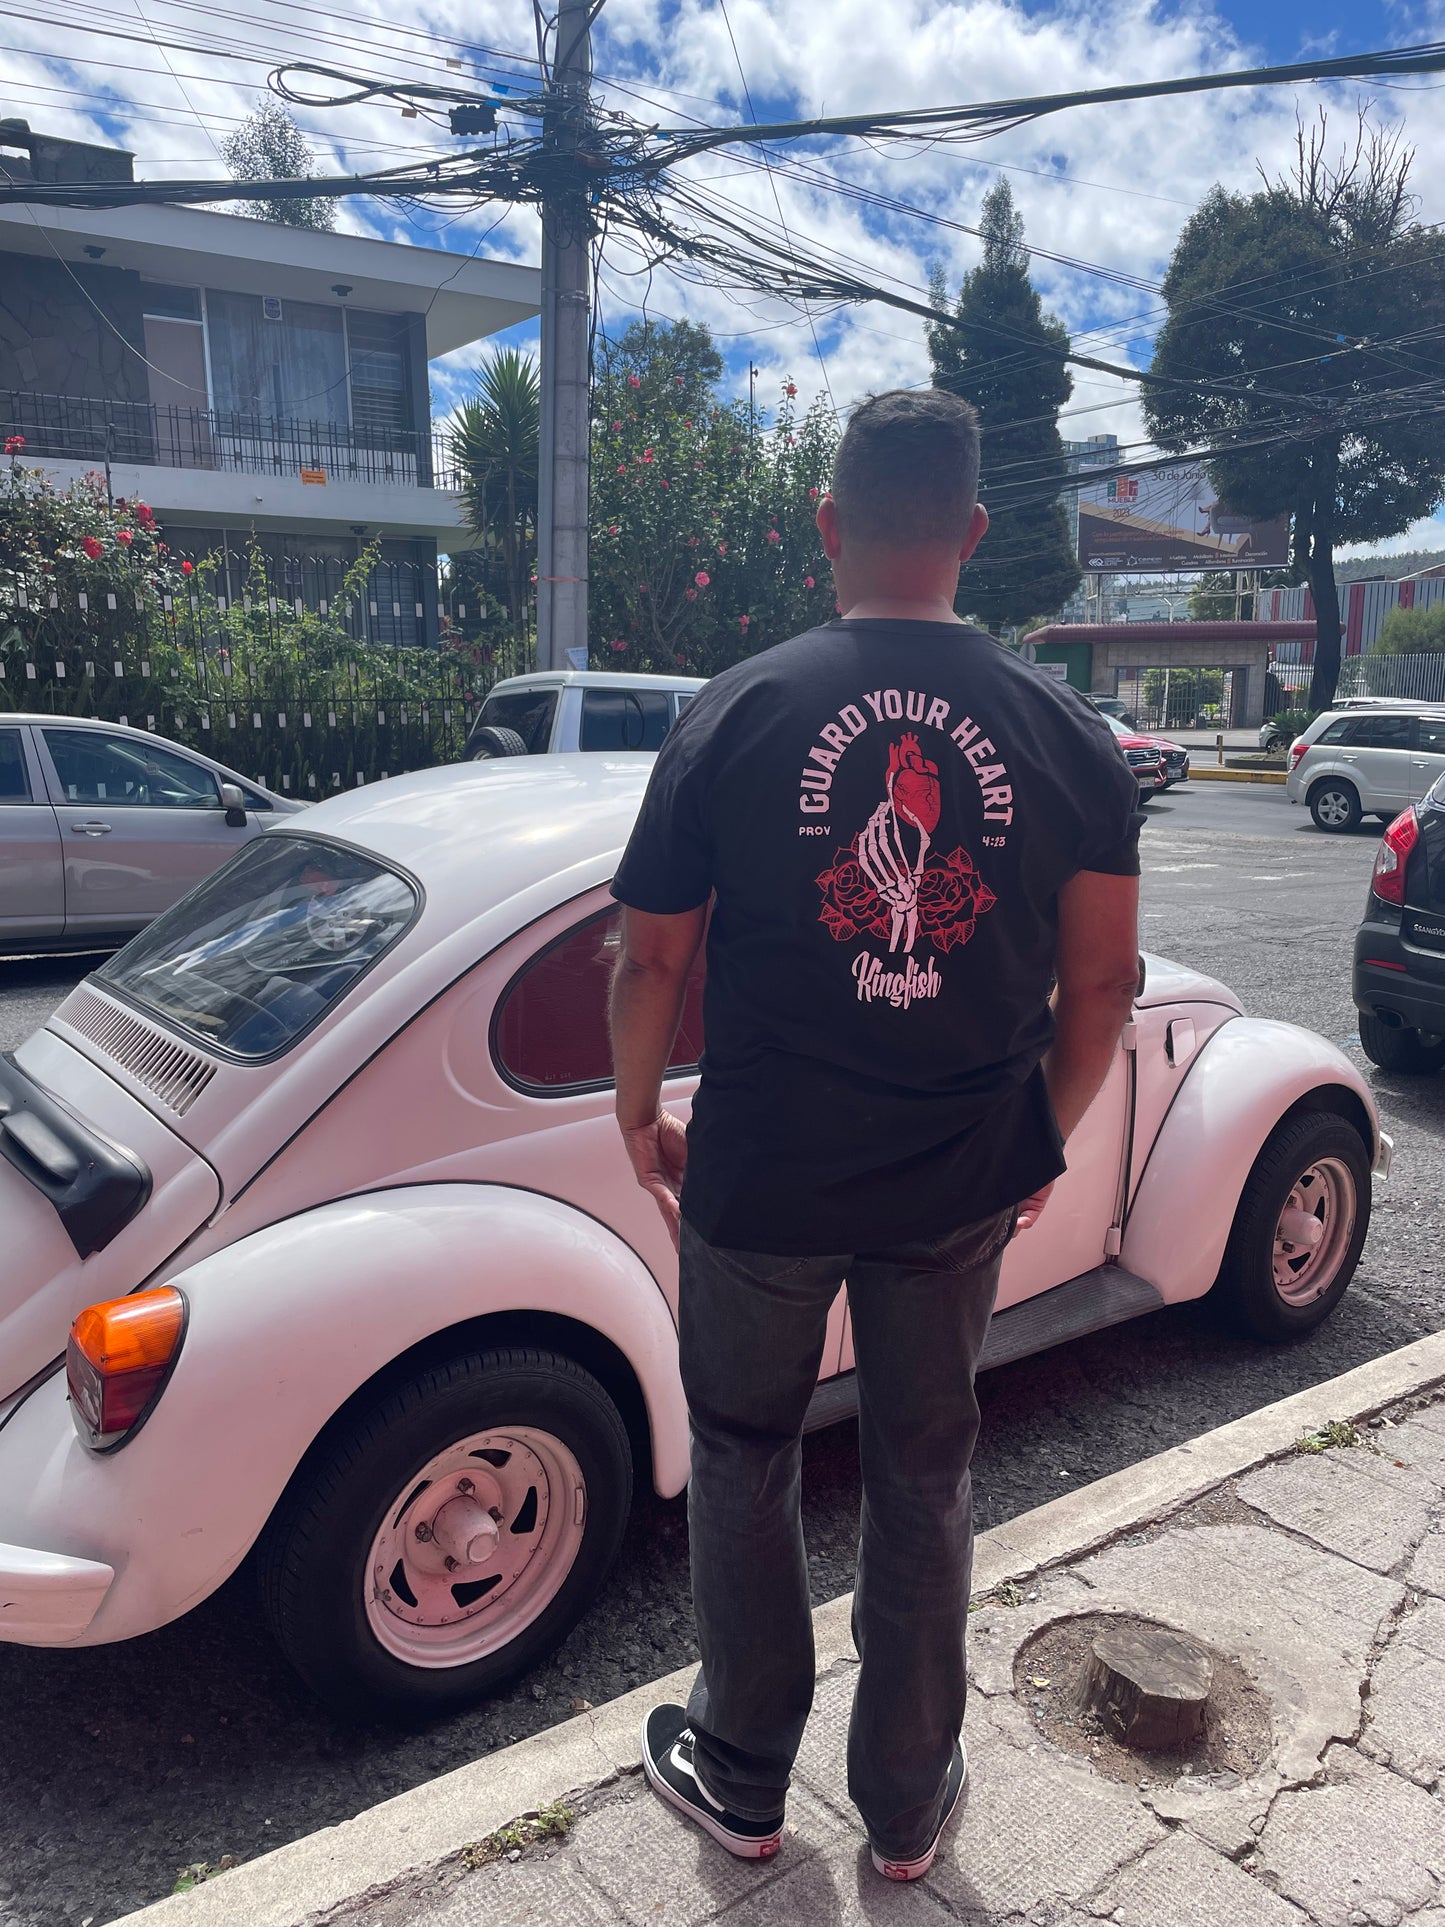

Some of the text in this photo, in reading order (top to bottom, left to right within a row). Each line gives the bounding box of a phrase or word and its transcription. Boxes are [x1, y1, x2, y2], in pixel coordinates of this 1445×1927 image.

[1152, 471, 1165, 481] 30
[1167, 470, 1179, 480] de
[1181, 469, 1206, 480] Junio
[1107, 496, 1137, 504] MUEBLE
[800, 688, 1015, 827] GUARD YOUR HEART
[798, 825, 832, 836] PROV
[851, 950, 943, 1011] Kingfish
